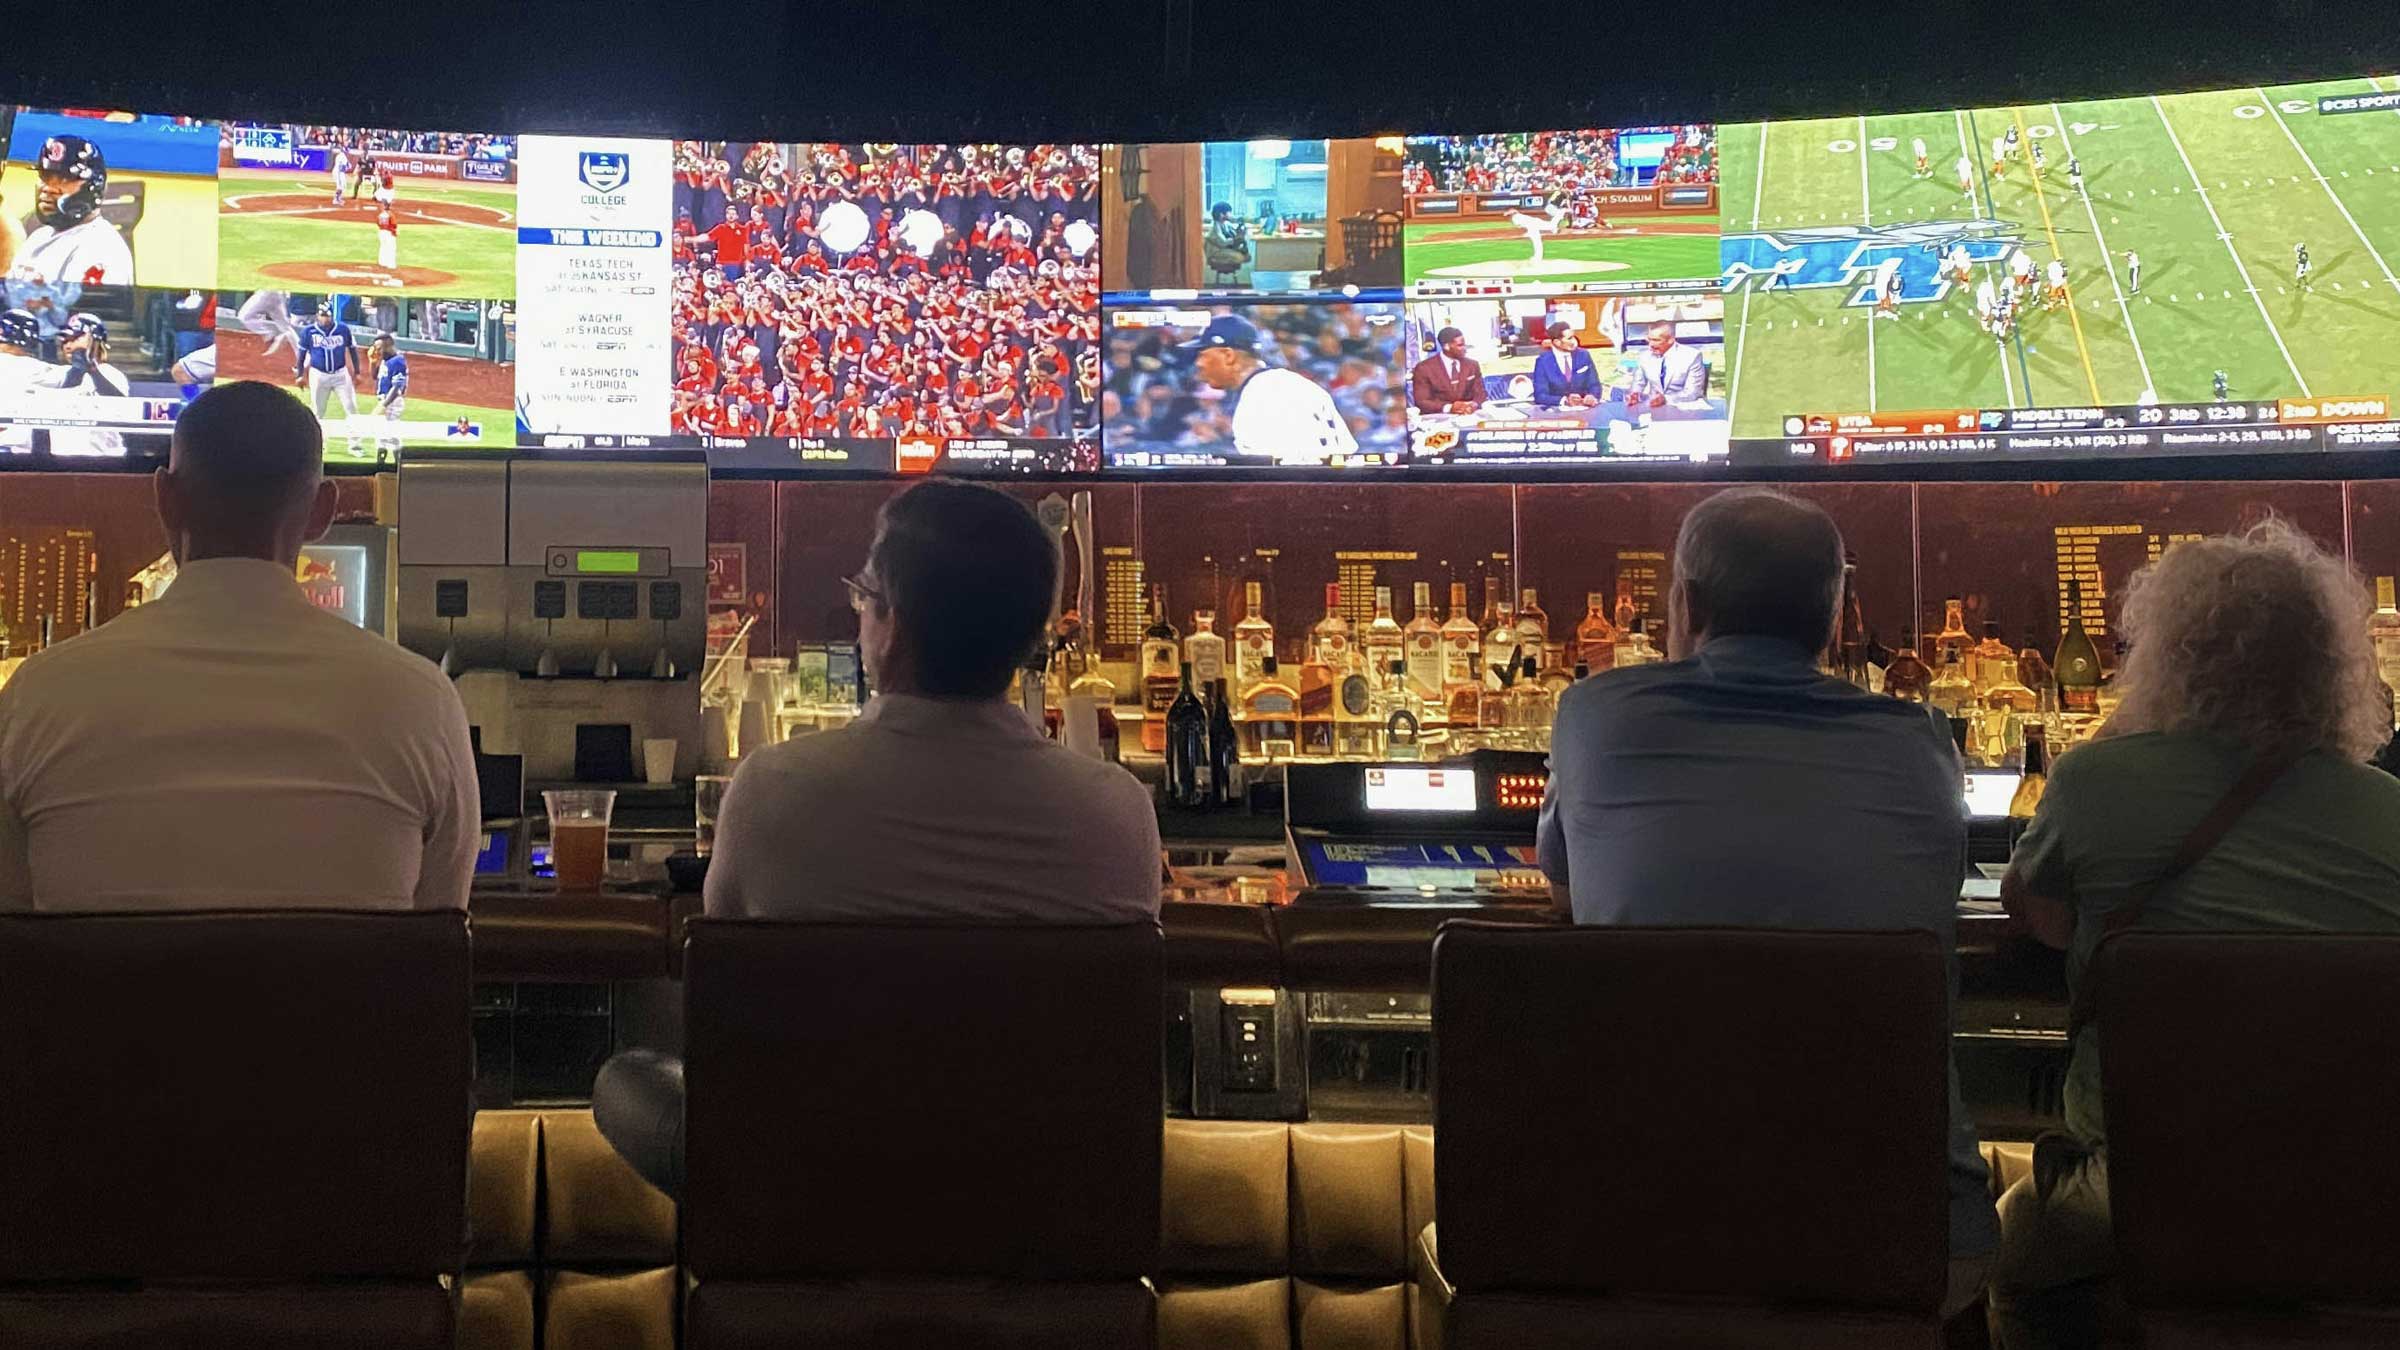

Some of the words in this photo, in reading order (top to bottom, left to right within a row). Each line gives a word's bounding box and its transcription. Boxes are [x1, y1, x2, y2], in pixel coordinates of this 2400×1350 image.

[376, 161, 409, 171] TRUIST
[424, 163, 448, 174] PARK
[580, 195, 627, 206] COLLEGE
[1610, 194, 1653, 204] STADIUM
[550, 229, 585, 246] THIS
[587, 230, 657, 248] WEEKEND
[569, 258, 603, 269] TEXAS
[608, 259, 634, 269] TECH
[581, 272, 626, 281] KANSAS
[578, 314, 623, 324] WAGNER
[578, 325, 634, 336] SYRACUSE
[570, 367, 640, 378] WASHINGTON
[583, 380, 628, 390] FLORIDA
[2012, 409, 2064, 422] MIDDLE
[2139, 408, 2163, 423] 20
[2321, 401, 2385, 417] DOWN
[1958, 415, 1974, 428] 31
